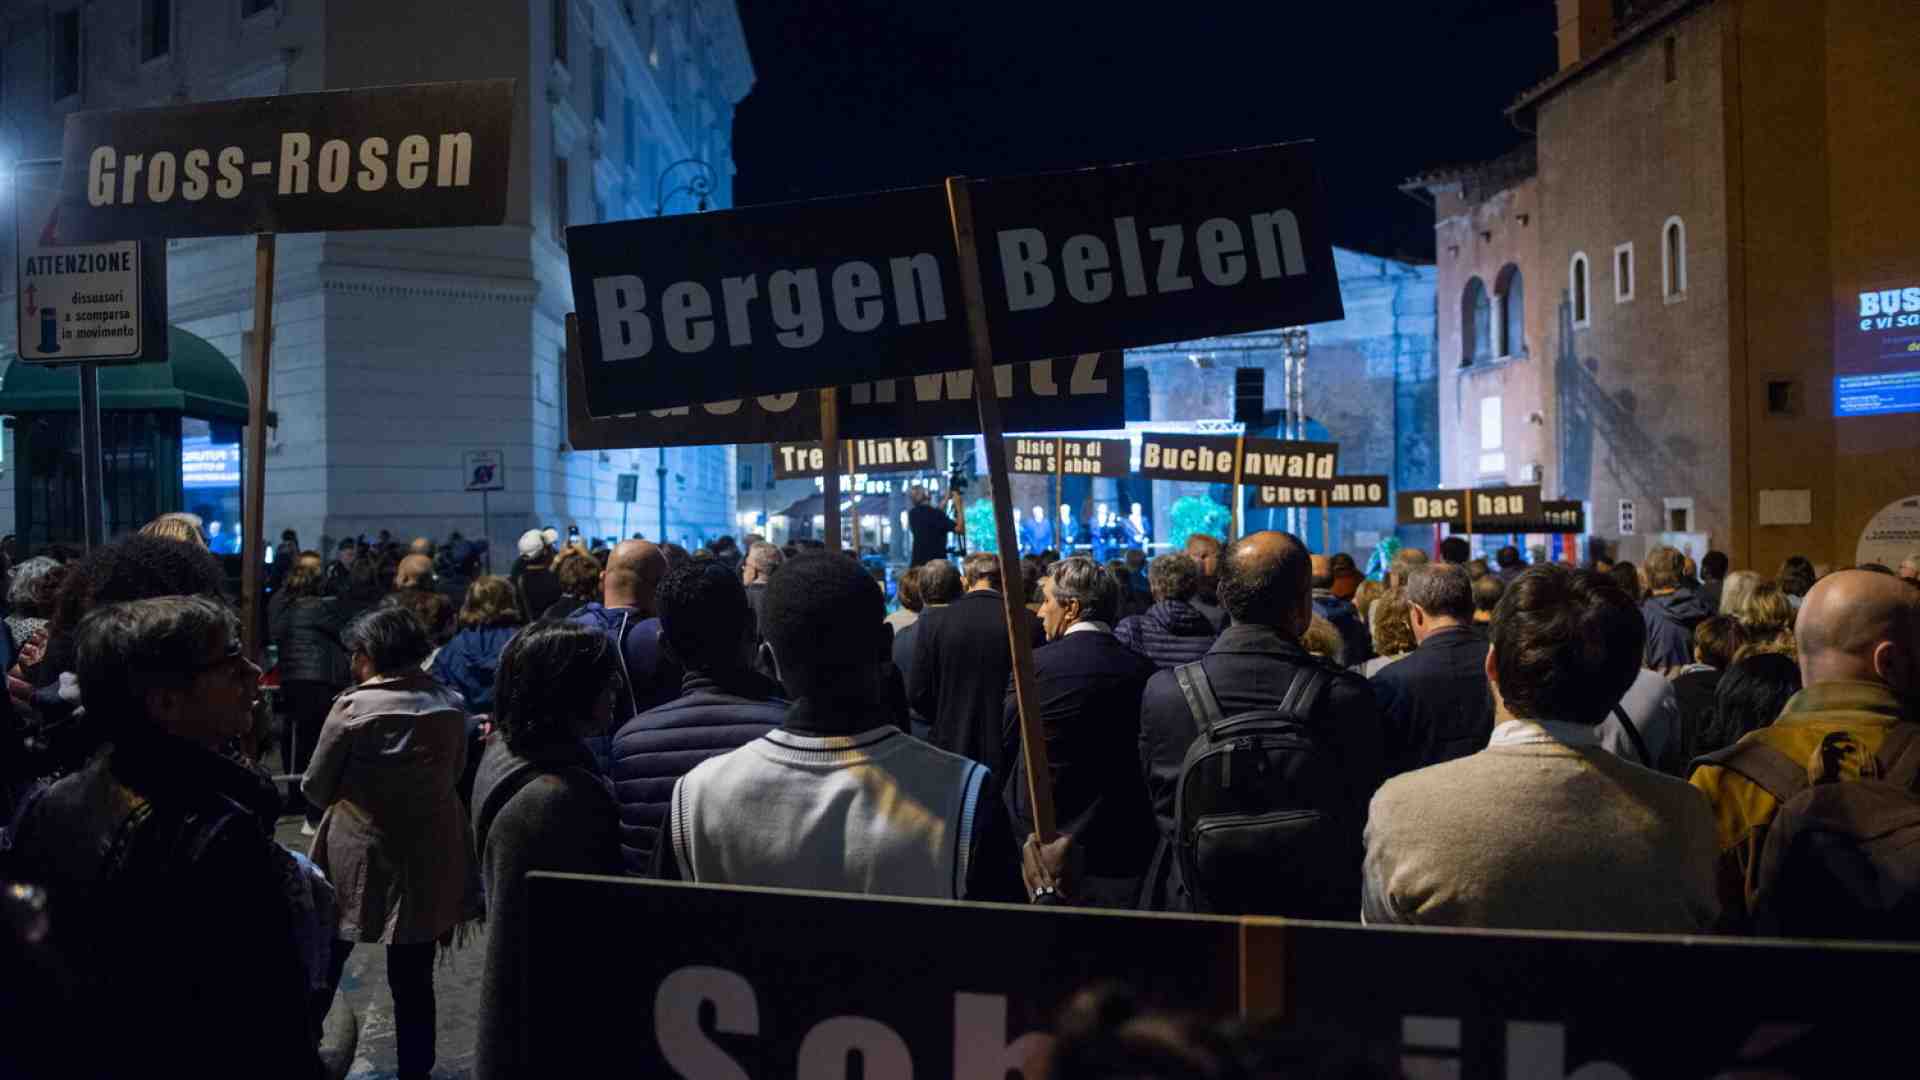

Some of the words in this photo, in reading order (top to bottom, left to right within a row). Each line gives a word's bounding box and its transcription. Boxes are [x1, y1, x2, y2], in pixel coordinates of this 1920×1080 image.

[86, 130, 473, 207] Gross-Rosen
[26, 252, 131, 275] ATTENZIONE
[592, 249, 949, 363] Bergen
[996, 207, 1307, 312] Belzen
[72, 290, 124, 304] dissuasori
[1860, 287, 1920, 317] BUS
[75, 309, 131, 323] scomparsa
[1860, 319, 1872, 331] e
[1876, 317, 1893, 329] vi
[62, 327, 73, 339] in
[76, 325, 135, 338] movimento
[780, 438, 929, 472] Trelinka
[1086, 442, 1102, 457] di
[1014, 456, 1041, 472] San
[1046, 457, 1101, 473] Sabba
[1143, 443, 1334, 480] Buchenwald
[1413, 493, 1524, 518] Dachau
